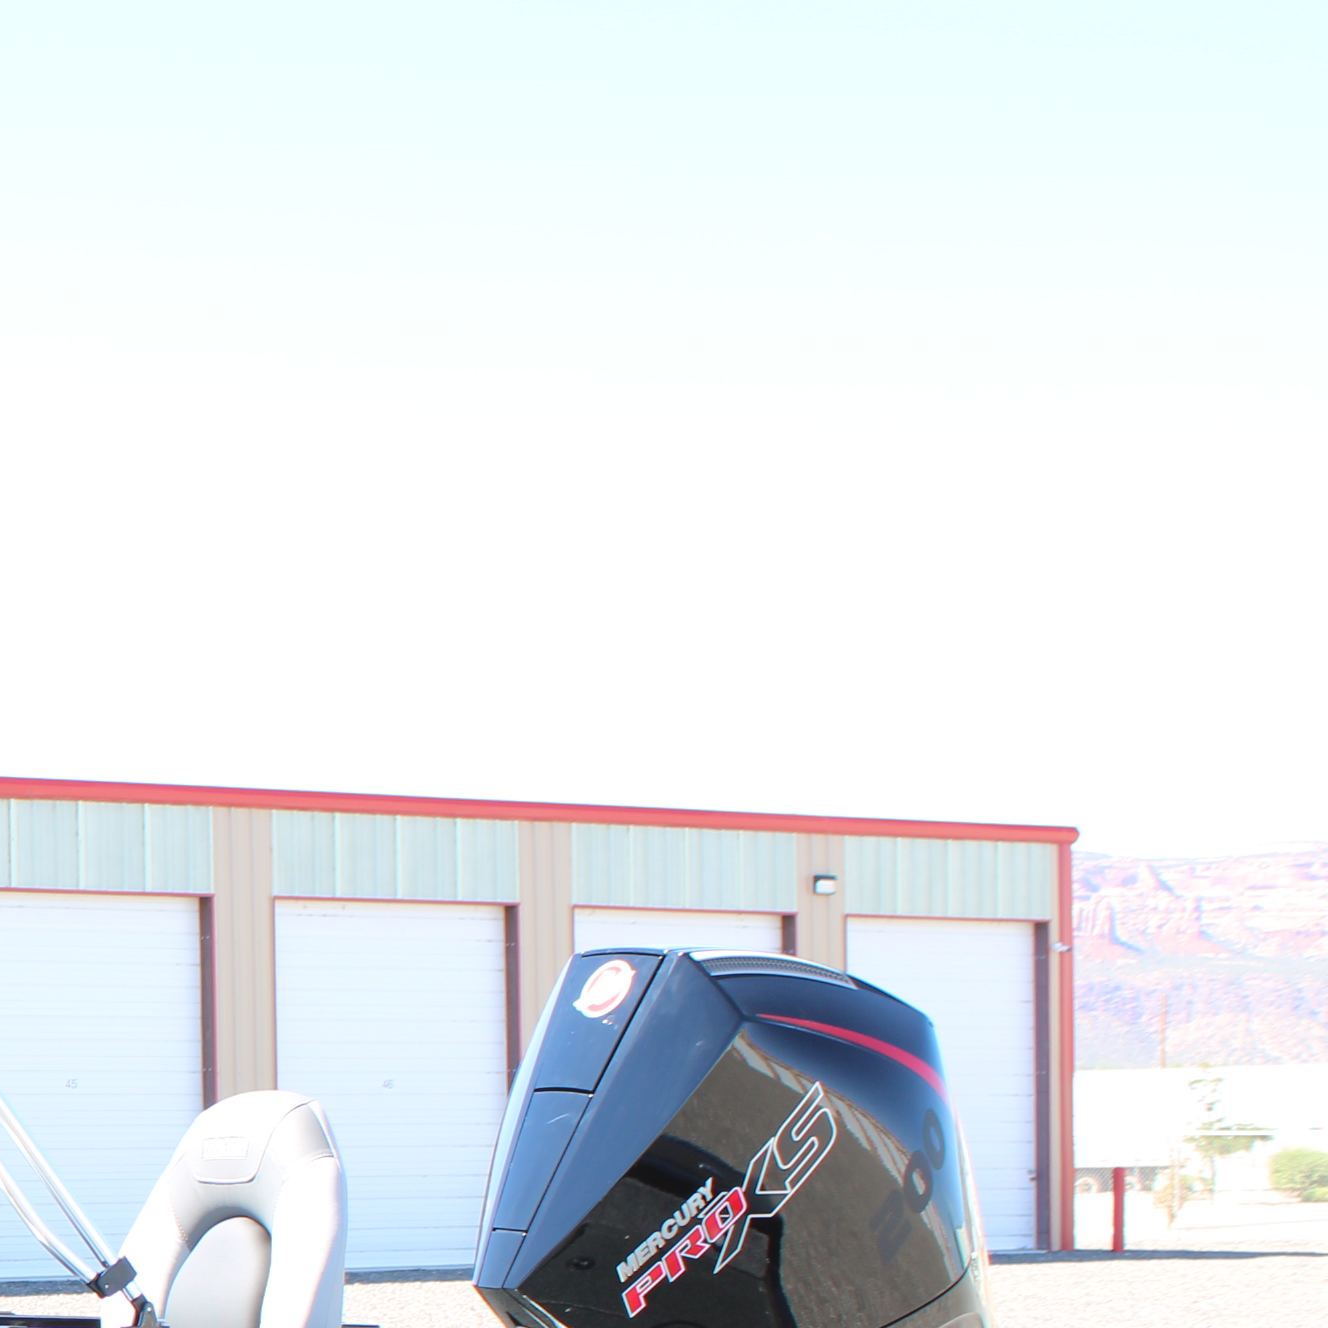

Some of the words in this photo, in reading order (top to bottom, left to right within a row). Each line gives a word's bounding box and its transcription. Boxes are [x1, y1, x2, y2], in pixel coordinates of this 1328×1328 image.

[65, 1078, 78, 1089] 45
[616, 1176, 715, 1283] MERCURY
[869, 1108, 945, 1268] 200
[621, 1186, 748, 1319] PRO
